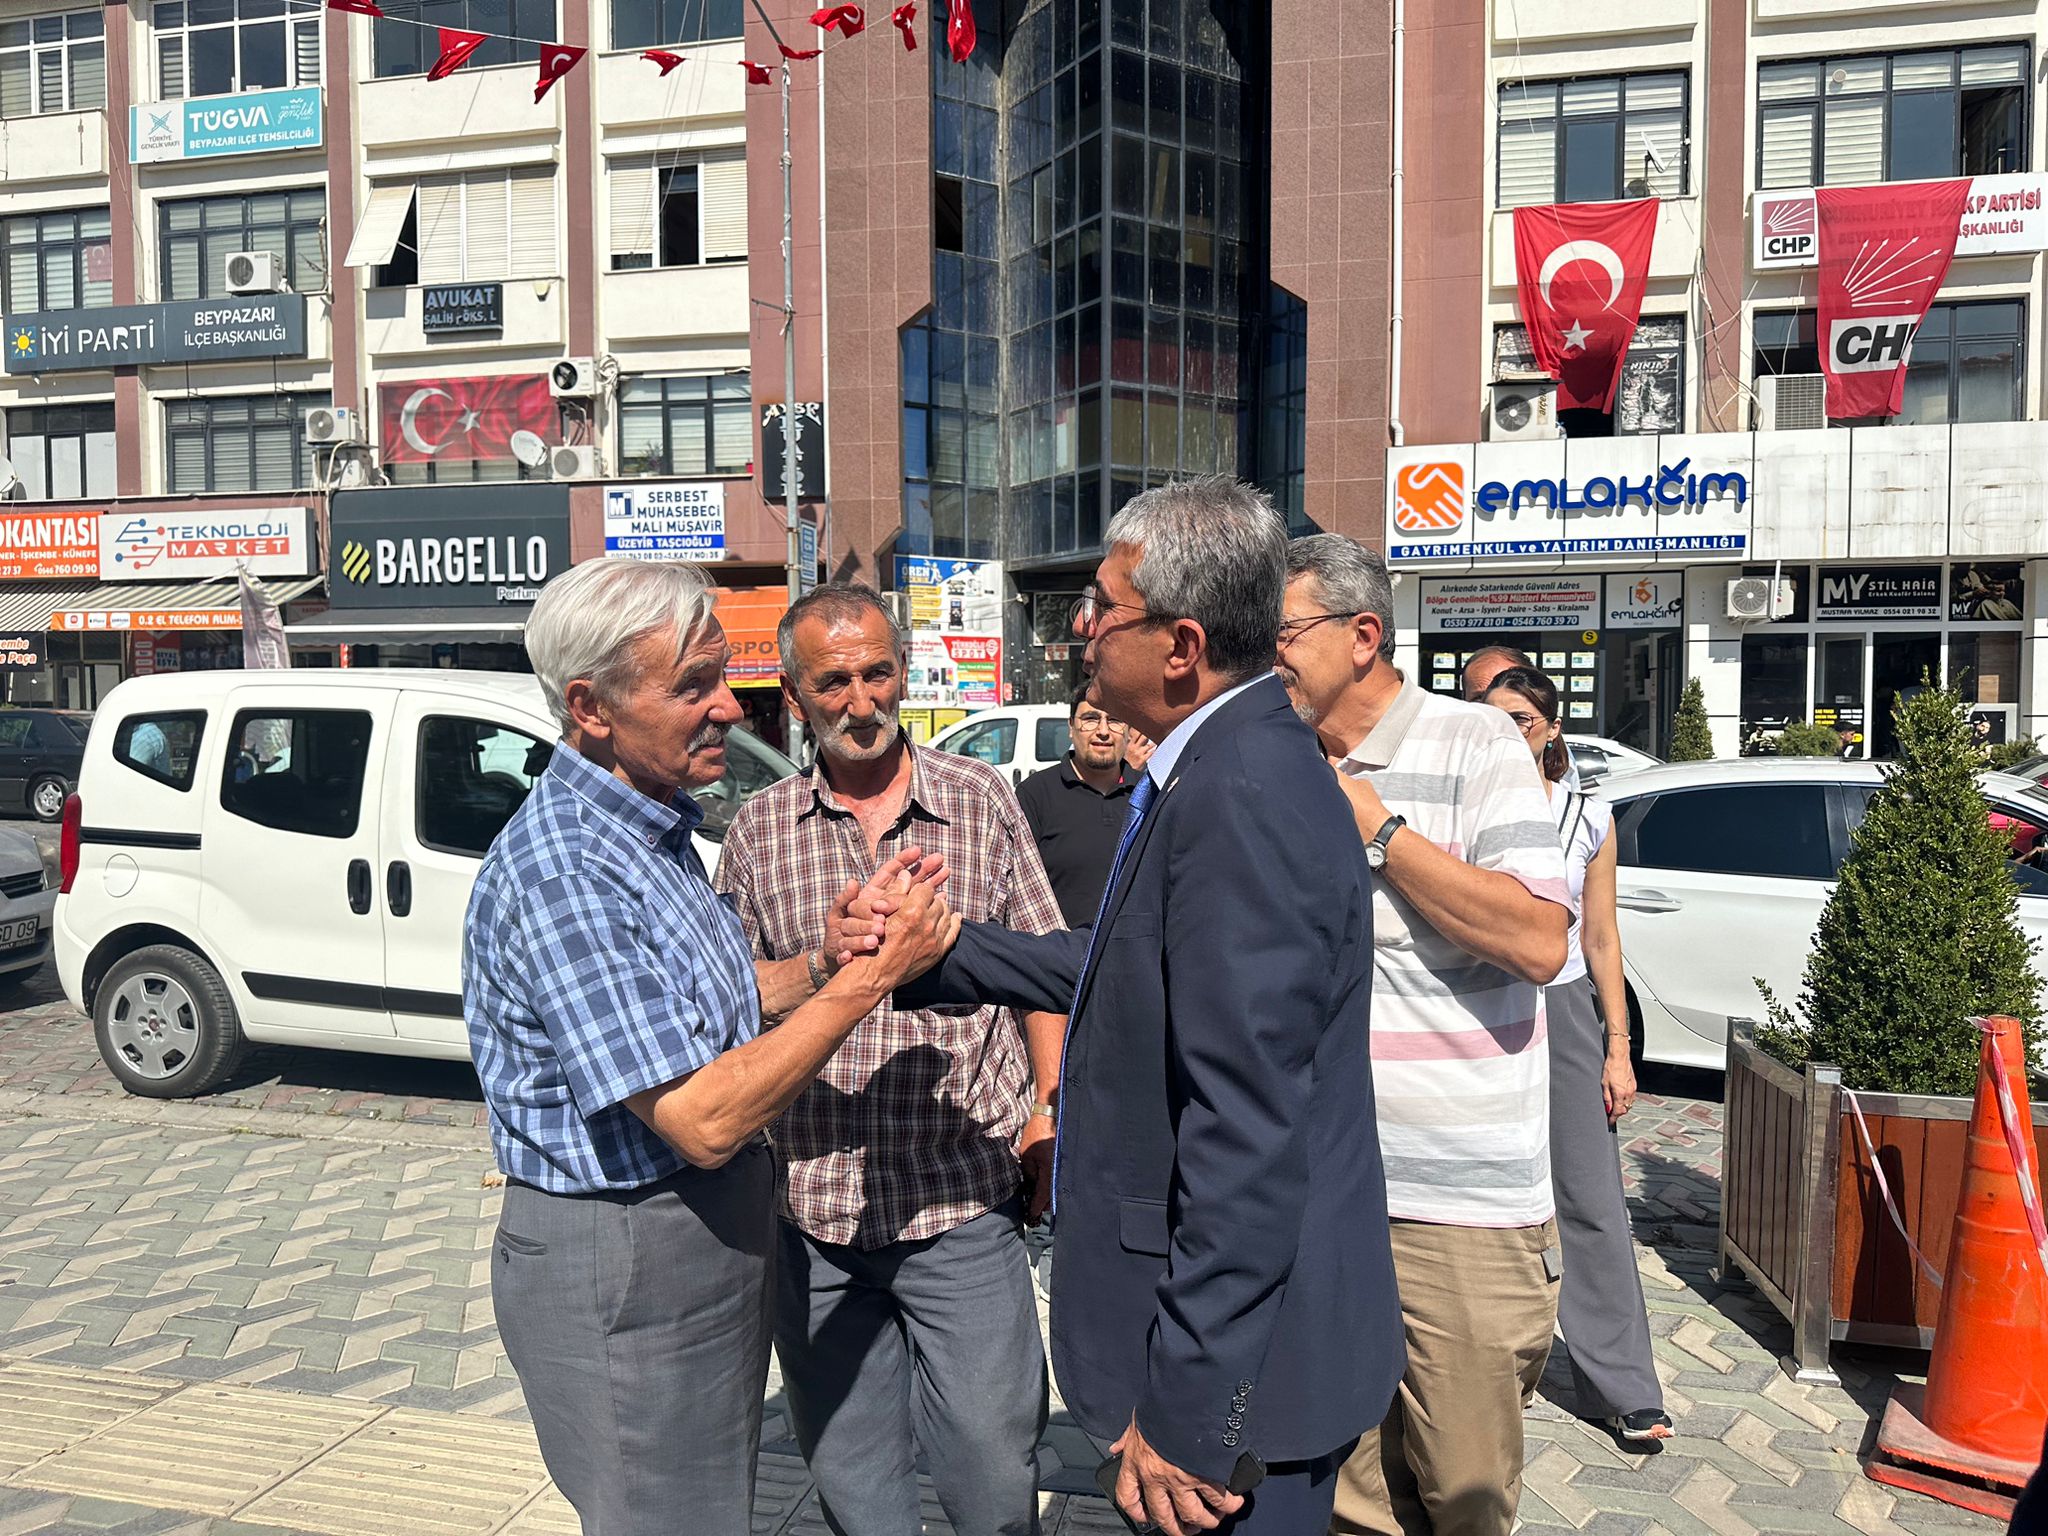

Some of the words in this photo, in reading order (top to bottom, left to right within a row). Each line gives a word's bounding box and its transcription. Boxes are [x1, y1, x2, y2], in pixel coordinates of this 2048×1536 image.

[189, 106, 270, 133] TÜGVA
[189, 137, 237, 149] BEYPAZARI
[238, 133, 257, 145] İLÇE
[1976, 187, 2041, 214] PARTİSİ
[1768, 237, 1811, 255] CHP
[425, 288, 495, 308] AVUKAT
[194, 306, 277, 327] BEYPAZARI
[41, 325, 70, 356] İYİ
[77, 319, 155, 353] PARTİ
[184, 331, 212, 349] İLÇE
[213, 320, 287, 347] BAŞKANLIĞI
[1836, 323, 1916, 365] CH
[648, 490, 708, 503] SERBEST
[637, 505, 720, 518] MUHASEBECİ
[667, 520, 722, 535] MÜŞAVİR
[171, 540, 286, 557] MARKET
[617, 537, 654, 549] ÜZEYİR
[1401, 543, 1515, 558] GAYRİMENKUL
[1519, 544, 1537, 553] ve
[1540, 539, 1607, 552] YATIRIM
[1613, 534, 1736, 552] DANIŞMANLIĞI
[376, 536, 548, 584] BARGELLO
[497, 587, 541, 600] Perfum
[1479, 583, 1524, 592] Satarkende
[1525, 582, 1555, 590] Güvenli
[1557, 582, 1580, 590] Adres
[1823, 574, 1870, 604] MY
[1425, 596, 1448, 605] Bölge
[1449, 595, 1489, 604] Genelinde
[1952, 601, 1971, 615] MY
[1481, 605, 1501, 614] İşyeri
[1557, 603, 1590, 611] Kiralama
[156, 615, 166, 625] EL
[169, 614, 209, 625] TELEFON
[1444, 619, 1466, 627] 0530
[1467, 619, 1483, 627] 977
[1484, 619, 1493, 627] 81
[1495, 619, 1505, 627] 01
[1511, 617, 1535, 626] 0546
[1536, 617, 1553, 625] 760
[1553, 616, 1565, 625] 39
[1566, 616, 1578, 625] 70
[1586, 632, 1594, 641] S
[730, 641, 778, 654] SPO
[954, 649, 982, 658] SPOT
[7, 651, 38, 667] Paça
[17, 921, 35, 938] 09
